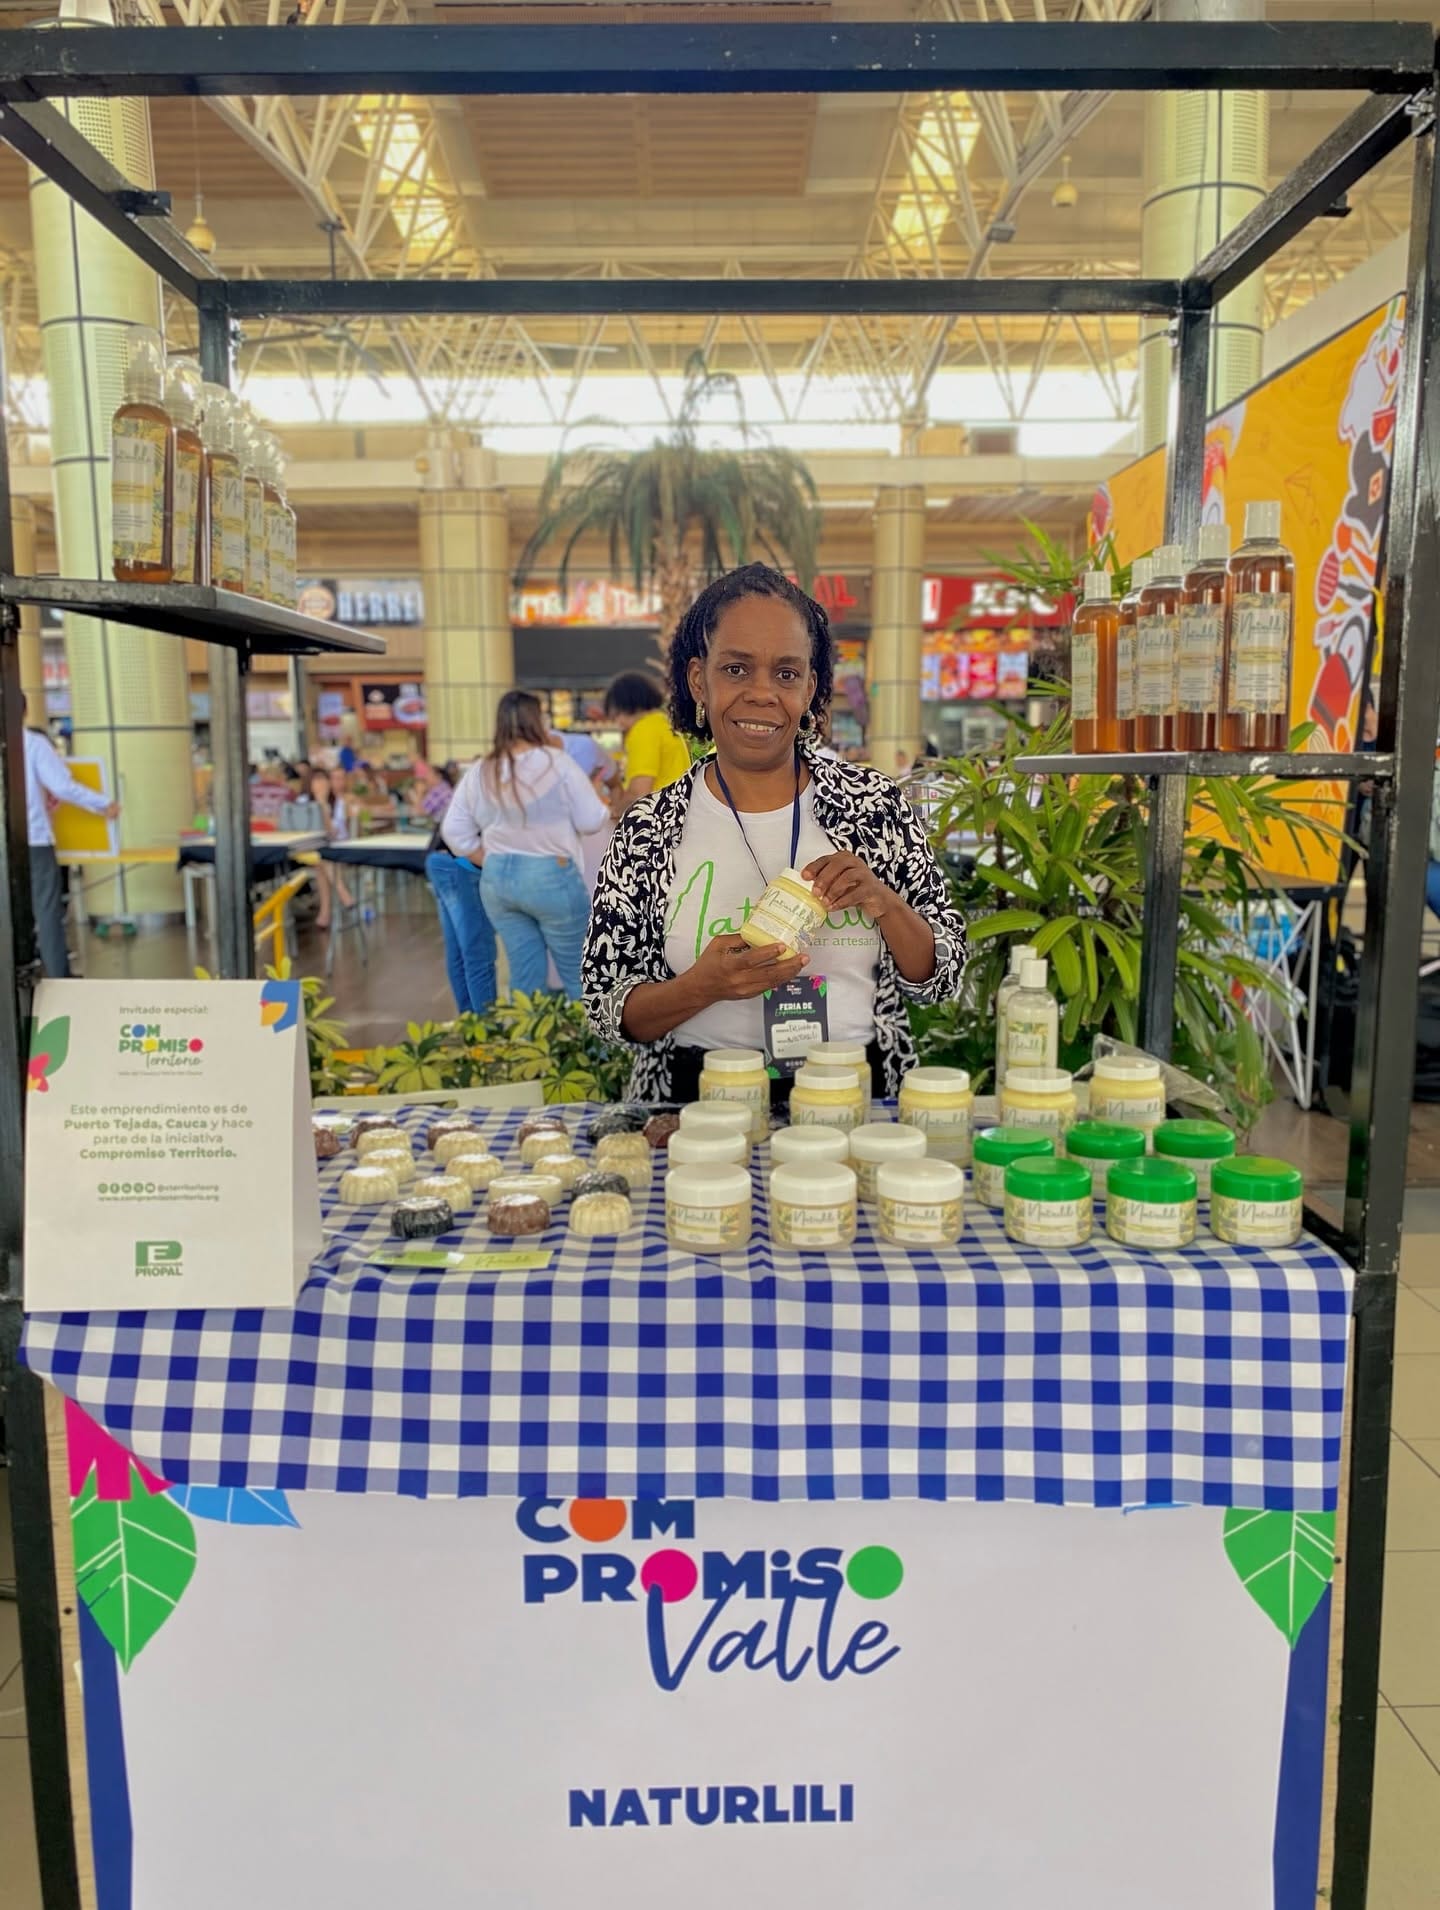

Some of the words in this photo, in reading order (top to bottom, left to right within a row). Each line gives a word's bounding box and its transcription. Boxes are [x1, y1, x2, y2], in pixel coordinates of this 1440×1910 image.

[119, 1005, 161, 1015] Invitado
[779, 1002, 801, 1011] FERIA
[802, 1001, 813, 1010] DE
[119, 1023, 161, 1038] COM
[118, 1037, 204, 1053] PROMISO
[142, 1050, 204, 1069] Territorio
[70, 1104, 98, 1115] Este
[101, 1103, 211, 1117] emprendimiento
[213, 1105, 228, 1114] es
[231, 1103, 248, 1114] de
[64, 1119, 110, 1130] Puerto
[113, 1118, 163, 1132] Tejada,
[165, 1118, 208, 1129] Cauca
[210, 1120, 219, 1131] y
[221, 1117, 254, 1129] hace
[93, 1134, 128, 1146] parte
[130, 1133, 147, 1144] de
[151, 1132, 162, 1144] la
[165, 1132, 223, 1144] iniciativa
[80, 1148, 166, 1160] Compromiso
[169, 1146, 237, 1159] Territorio.
[135, 1267, 183, 1277] PROPAL
[515, 1498, 695, 1543] COM
[646, 1578, 901, 1691] Valle
[568, 1784, 854, 1827] NATURLILI
